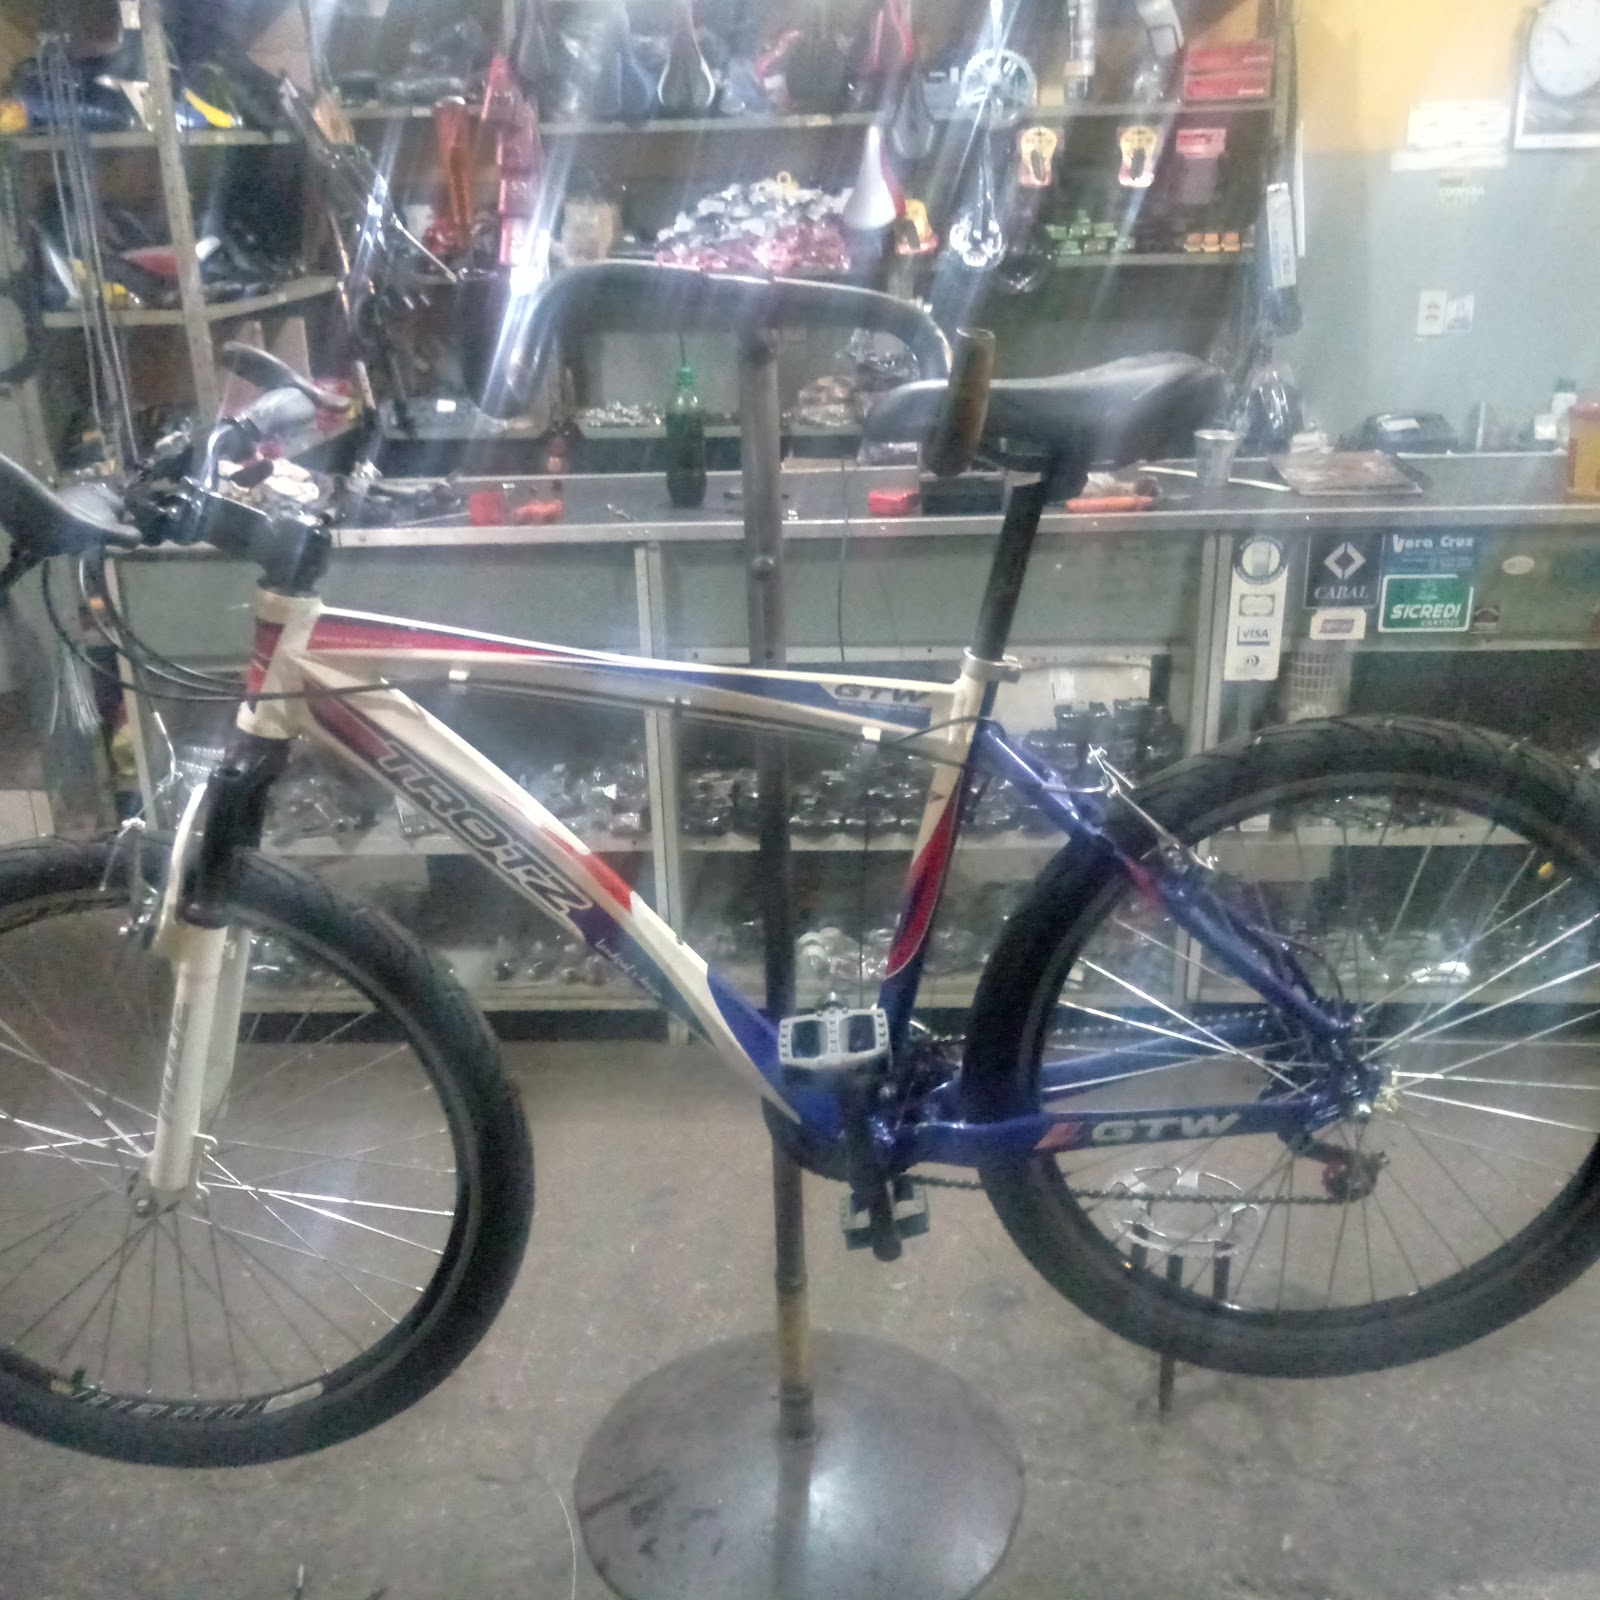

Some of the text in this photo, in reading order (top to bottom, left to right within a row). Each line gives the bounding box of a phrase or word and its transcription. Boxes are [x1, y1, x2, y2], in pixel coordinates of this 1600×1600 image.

[1314, 585, 1369, 600] CABAL
[1390, 603, 1462, 620] SICREDI
[1242, 628, 1269, 638] VISA
[834, 683, 931, 702] GTW
[1091, 1113, 1242, 1143] GTW
